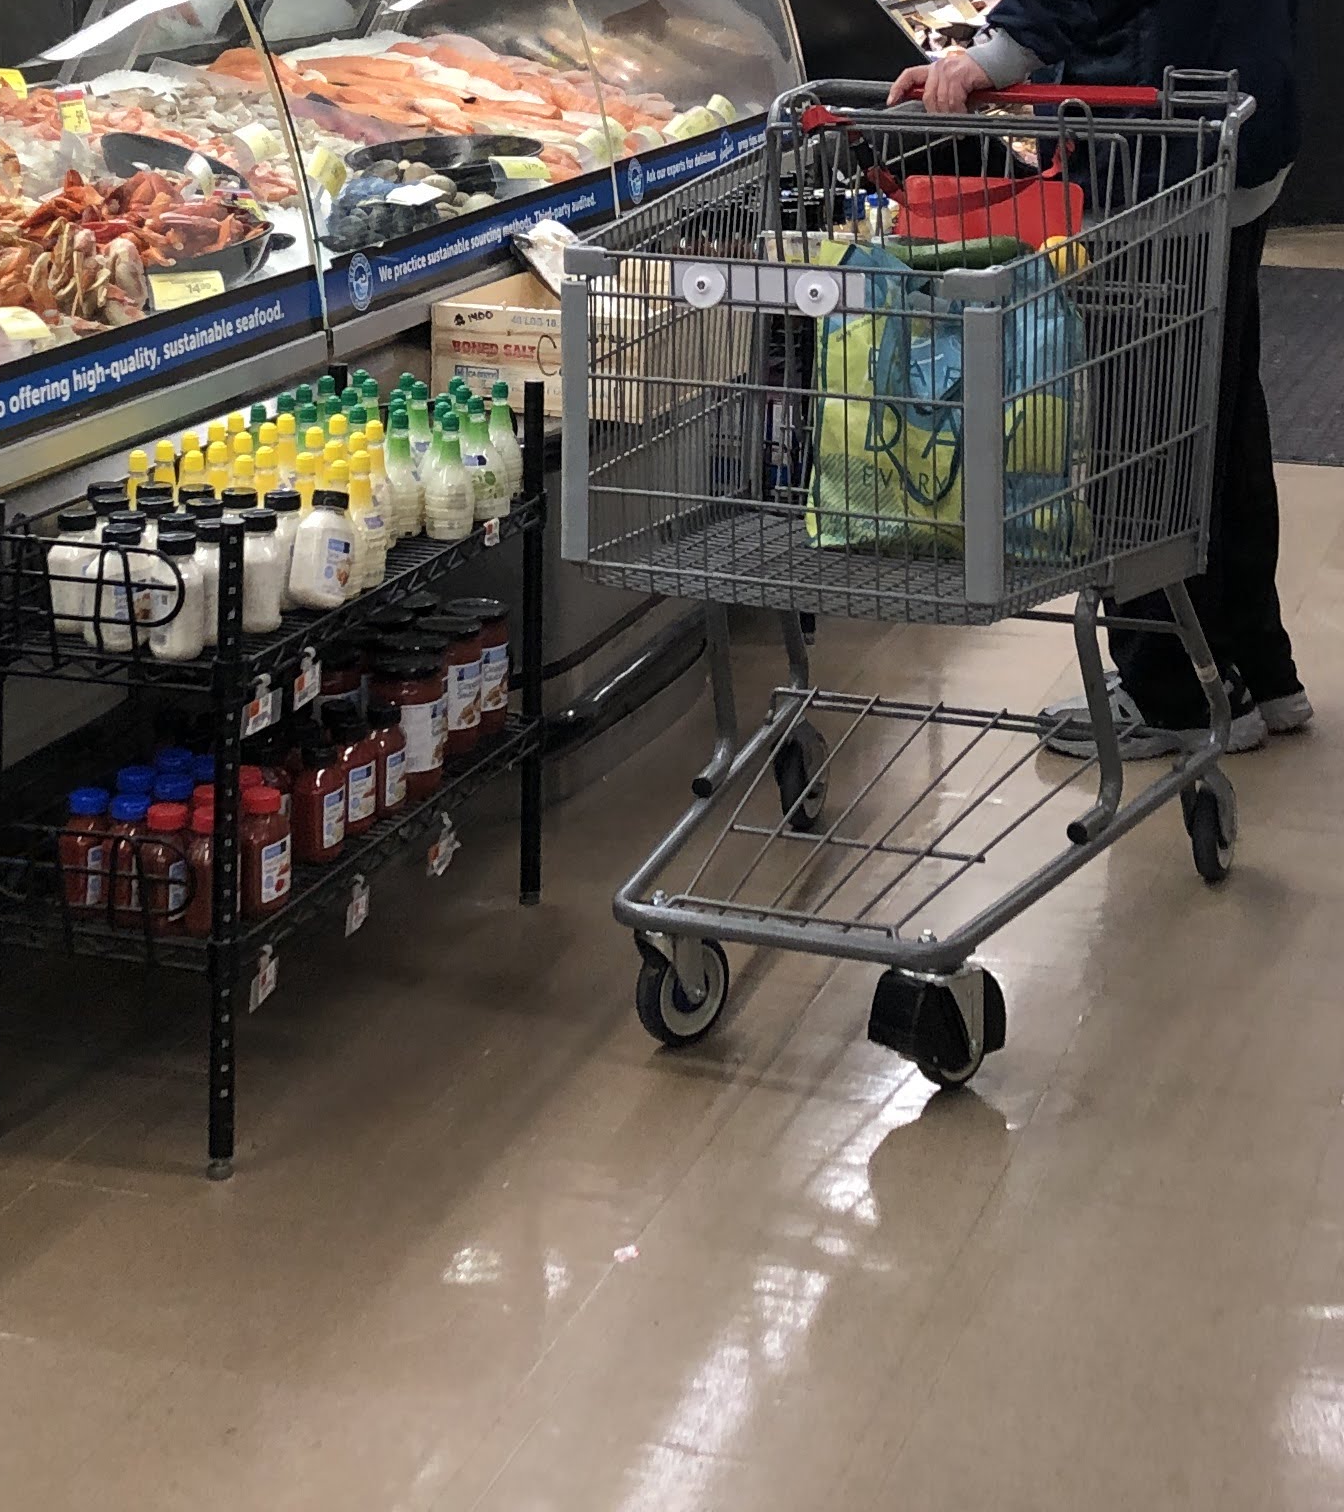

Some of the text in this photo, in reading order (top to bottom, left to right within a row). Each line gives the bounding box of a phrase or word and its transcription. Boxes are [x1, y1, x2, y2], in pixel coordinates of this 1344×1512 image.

[646, 169, 656, 184] Ask
[657, 167, 666, 180] our
[667, 161, 686, 178] experts
[377, 192, 597, 283] We practice sustainable sourcing methods. Third-party audited.
[9, 378, 71, 416] offering
[72, 348, 162, 394] high-quality,
[162, 321, 235, 360] sustainable
[236, 300, 286, 337] seafood.
[503, 343, 537, 359] SALT
